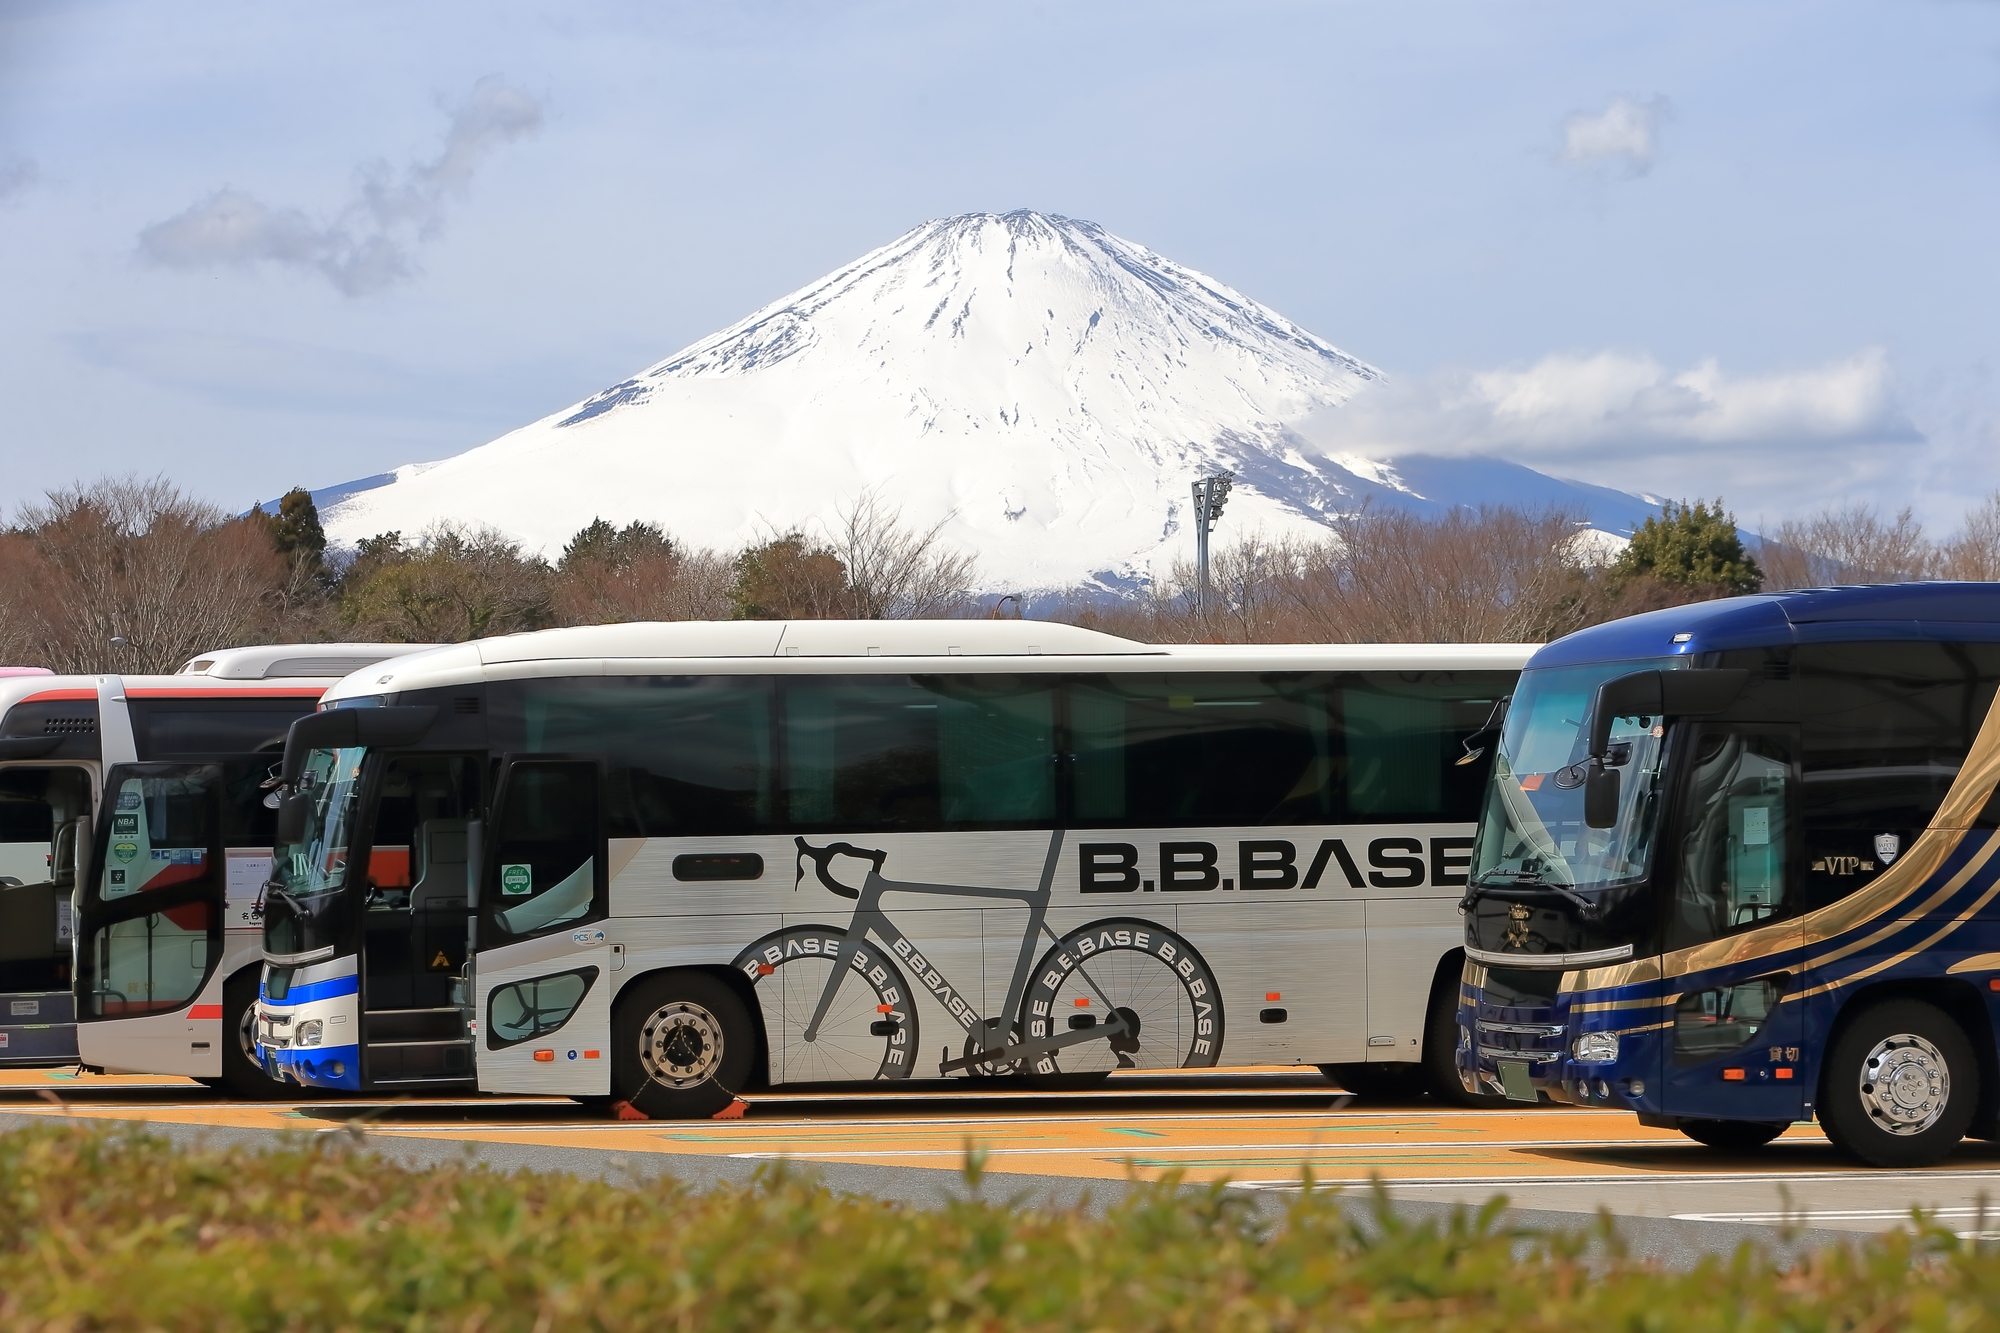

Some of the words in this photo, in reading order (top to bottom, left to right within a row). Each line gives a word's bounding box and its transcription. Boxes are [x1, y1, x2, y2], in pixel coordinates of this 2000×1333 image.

[117, 818, 135, 826] NBA
[1078, 837, 1476, 894] B.B.BASE
[1824, 856, 1860, 876] VIP
[573, 934, 589, 942] PCS
[892, 937, 978, 1029] B.B.BASE
[1157, 941, 1212, 1056] B.B.BASE
[1768, 1046, 1800, 1062] 貸切
